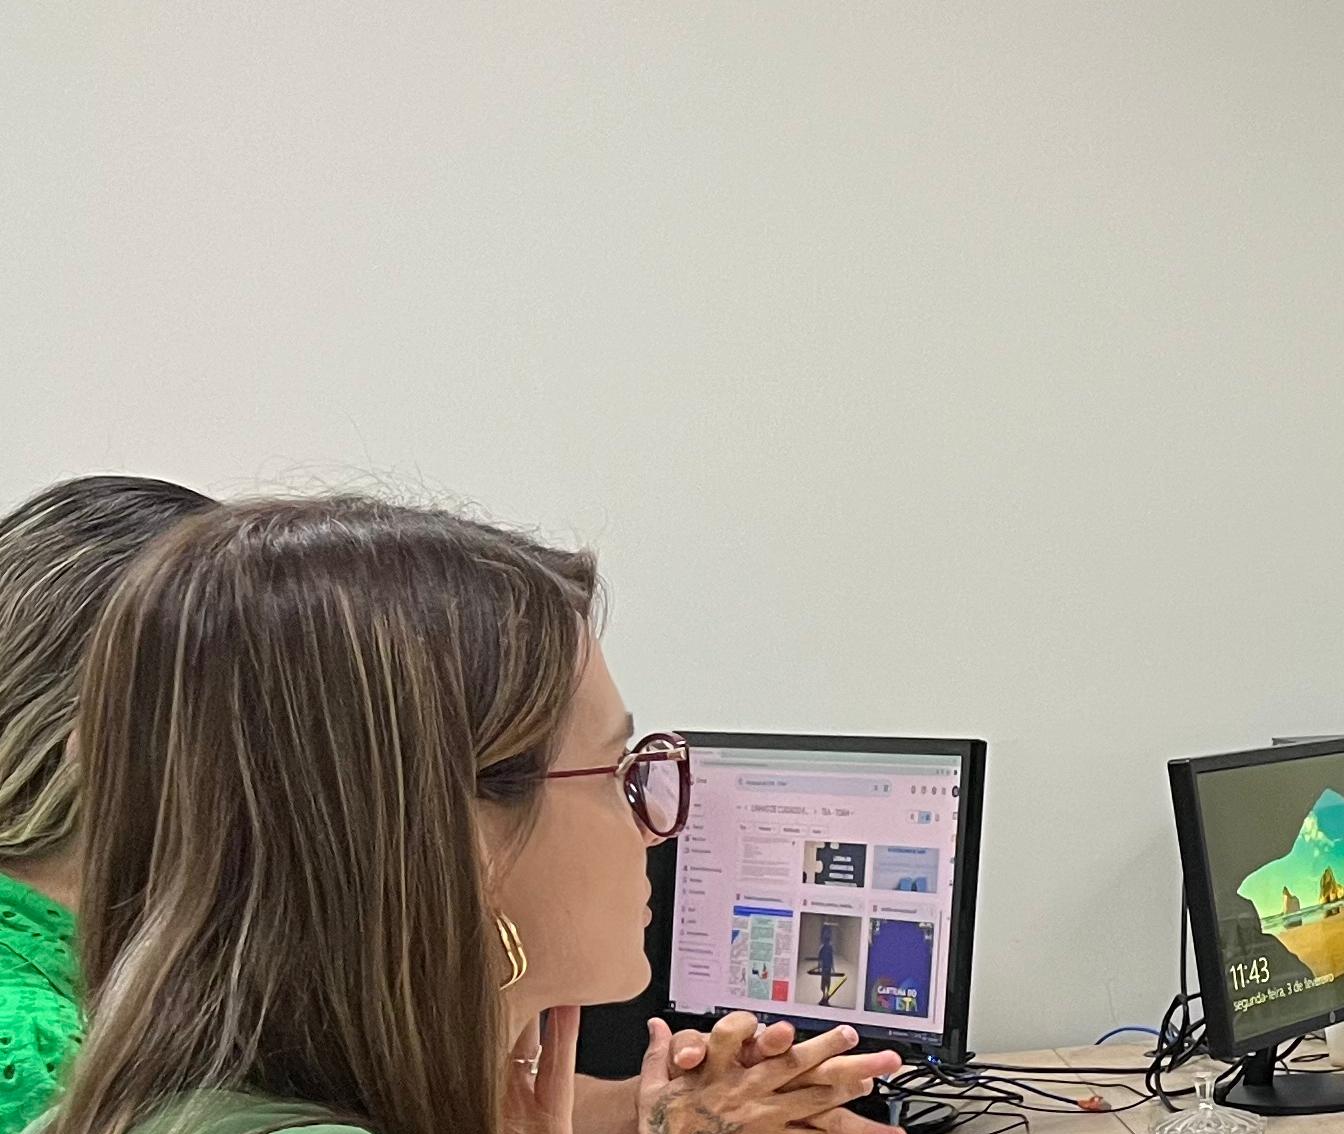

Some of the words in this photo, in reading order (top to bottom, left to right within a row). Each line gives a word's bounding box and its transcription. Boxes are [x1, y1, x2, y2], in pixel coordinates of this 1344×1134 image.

[1230, 957, 1270, 991] 11:43
[1287, 982, 1293, 995] 3
[1293, 980, 1304, 992] de
